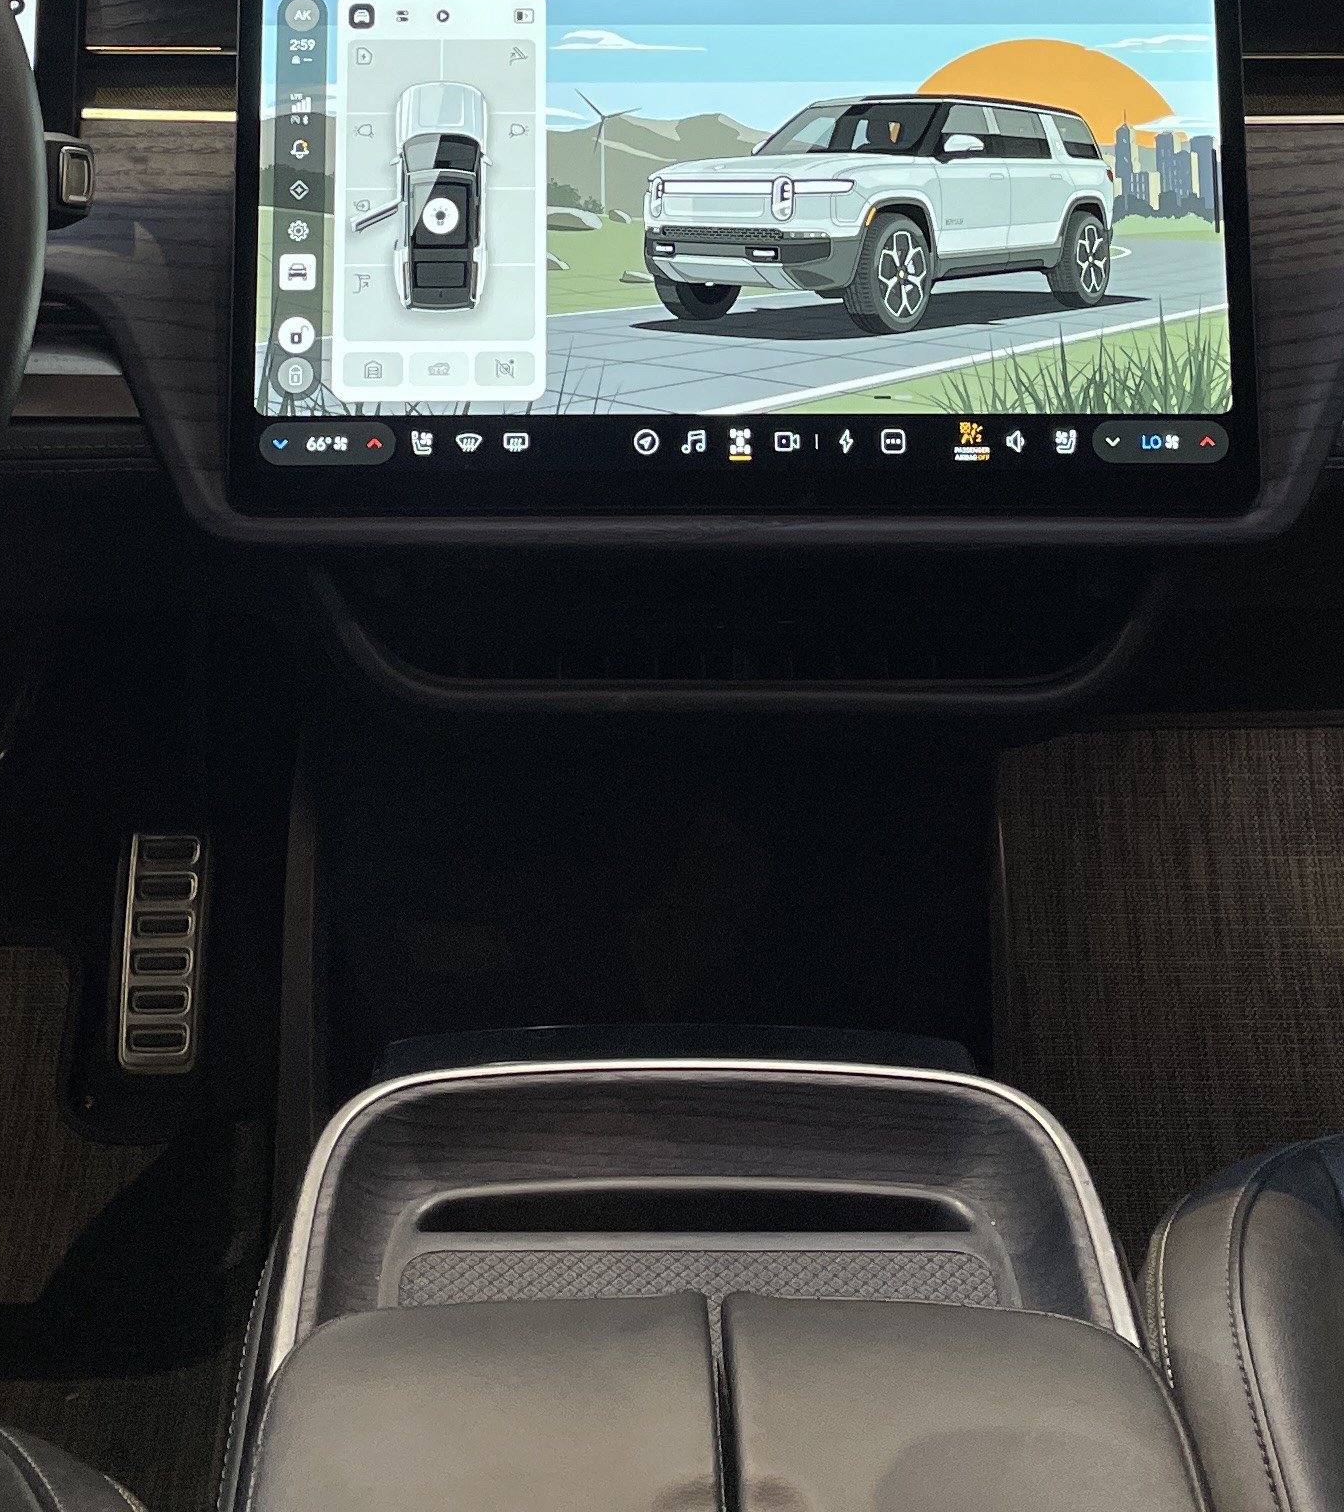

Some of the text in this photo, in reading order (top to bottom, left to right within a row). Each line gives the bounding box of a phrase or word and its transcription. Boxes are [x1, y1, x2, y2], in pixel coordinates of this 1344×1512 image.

[294, 9, 312, 21] AK
[289, 39, 316, 51] 2:59
[306, 436, 332, 451] 66°
[1142, 434, 1162, 449] LO
[954, 446, 991, 454] PASSENGER
